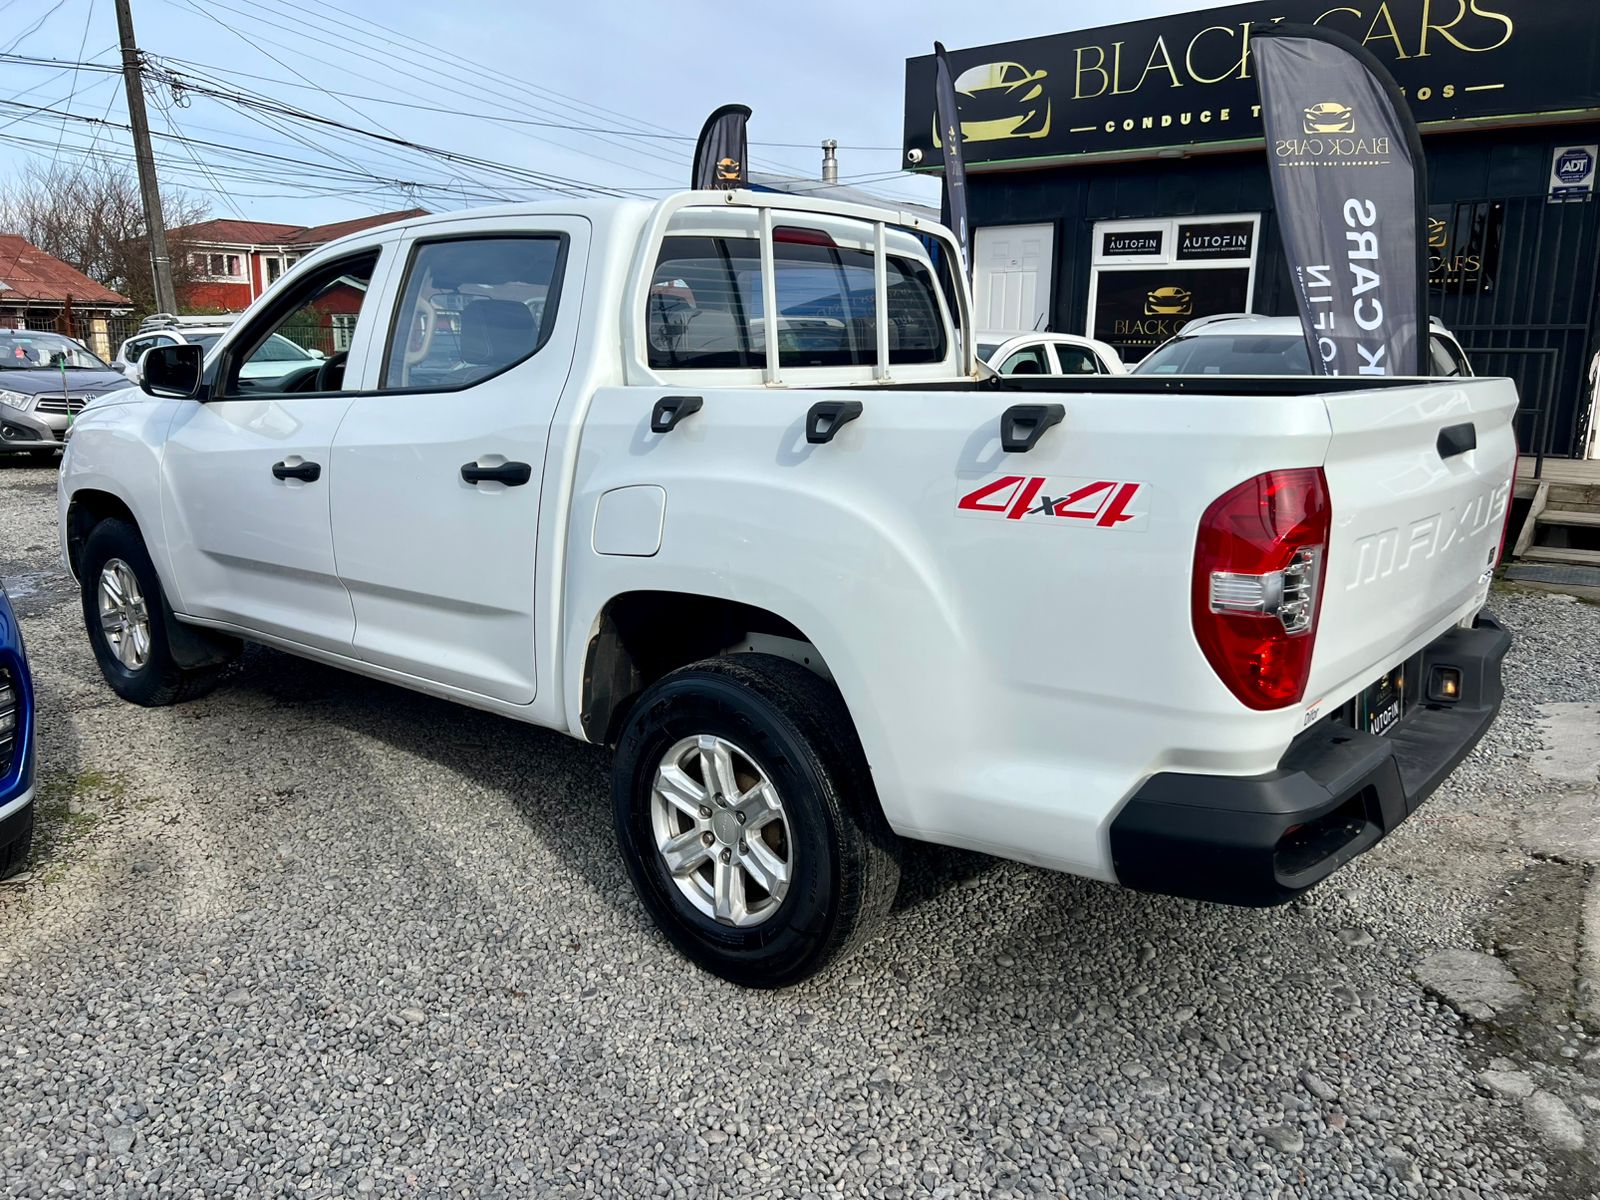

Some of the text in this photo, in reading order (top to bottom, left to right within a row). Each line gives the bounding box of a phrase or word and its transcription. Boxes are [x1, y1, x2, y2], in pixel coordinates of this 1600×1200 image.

[1105, 107, 1230, 133] CONDUCE
[1560, 159, 1588, 172] ADT
[1109, 238, 1157, 249] AUTOFIN
[1183, 233, 1248, 248] AUTOFIN
[1114, 319, 1169, 335] BLACK
[957, 475, 1141, 528] 4x4
[1345, 479, 1510, 591] MAXUS
